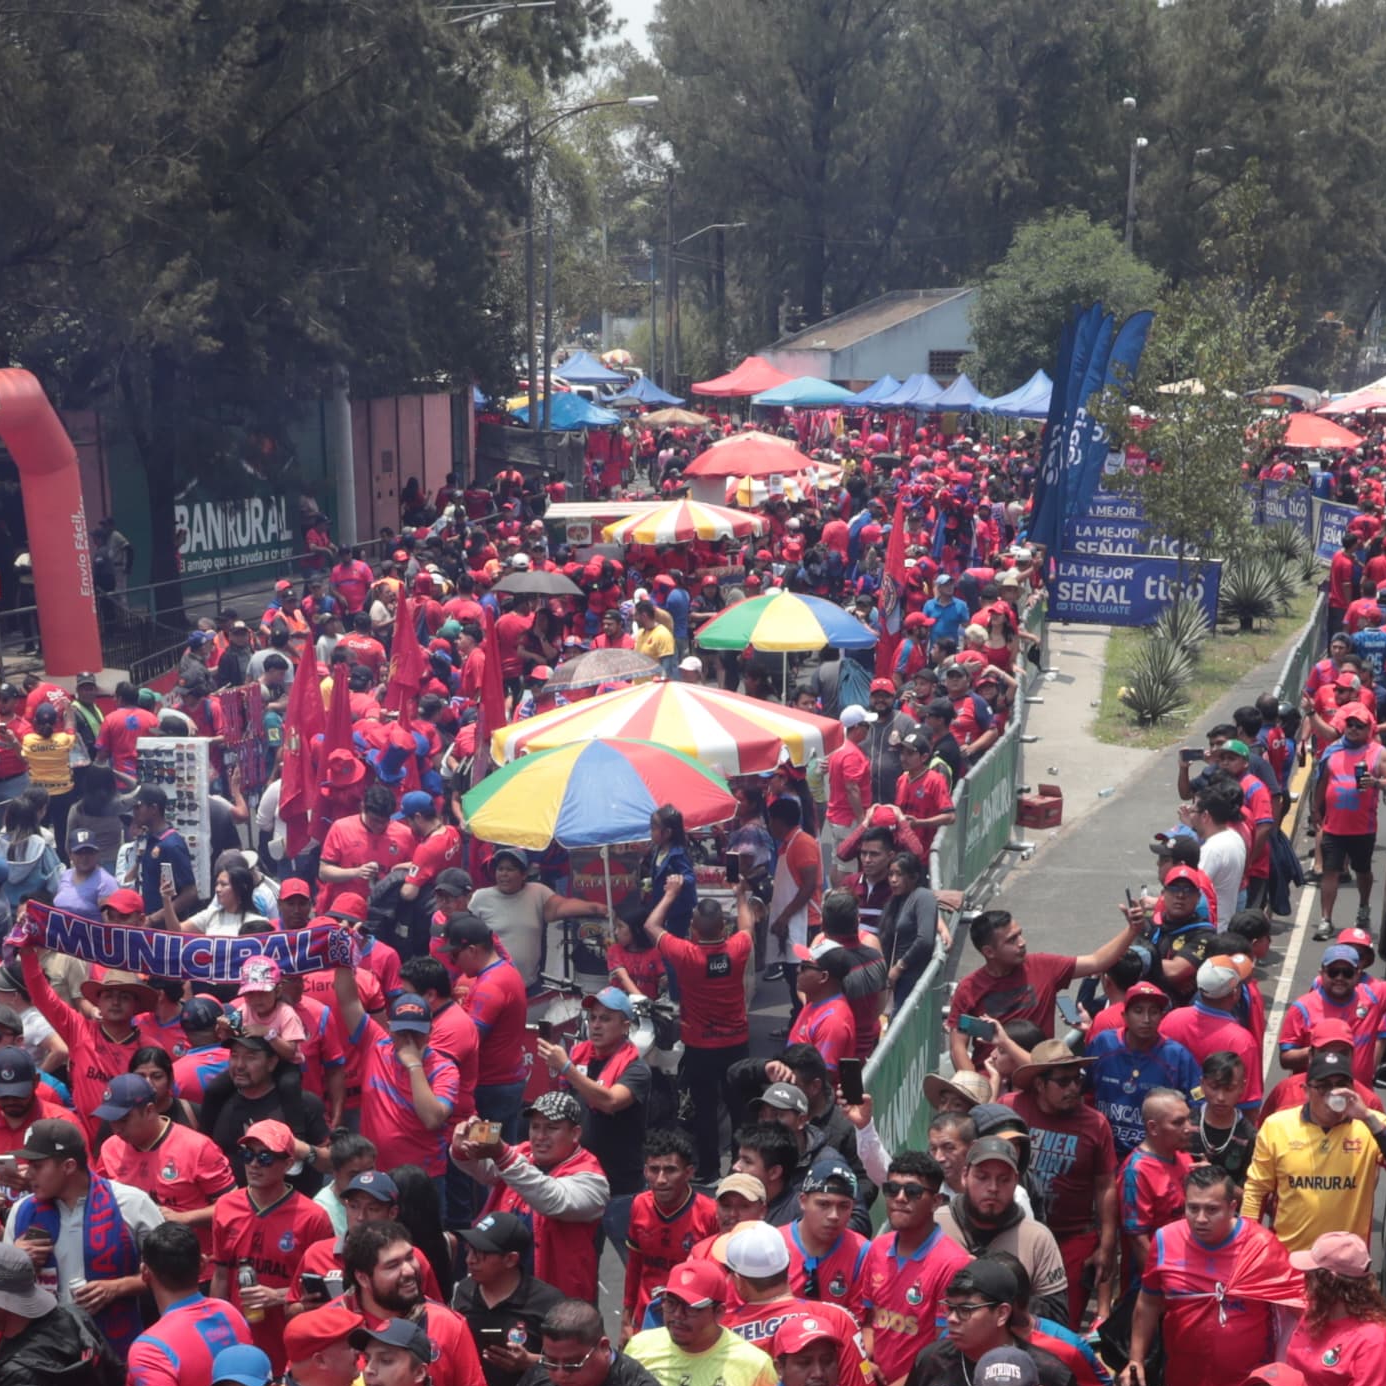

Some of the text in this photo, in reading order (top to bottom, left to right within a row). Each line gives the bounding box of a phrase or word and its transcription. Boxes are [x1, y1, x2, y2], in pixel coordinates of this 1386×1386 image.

[175, 496, 293, 556] BANRURAL
[1095, 527, 1138, 541] MEJOR
[1058, 564, 1134, 582] LA MEJOR
[1059, 578, 1132, 607] SEÑAL
[45, 911, 323, 982] MUNICIPAL
[1288, 1175, 1357, 1192] BANRURAL
[984, 1363, 1022, 1381] PATRIOTS
